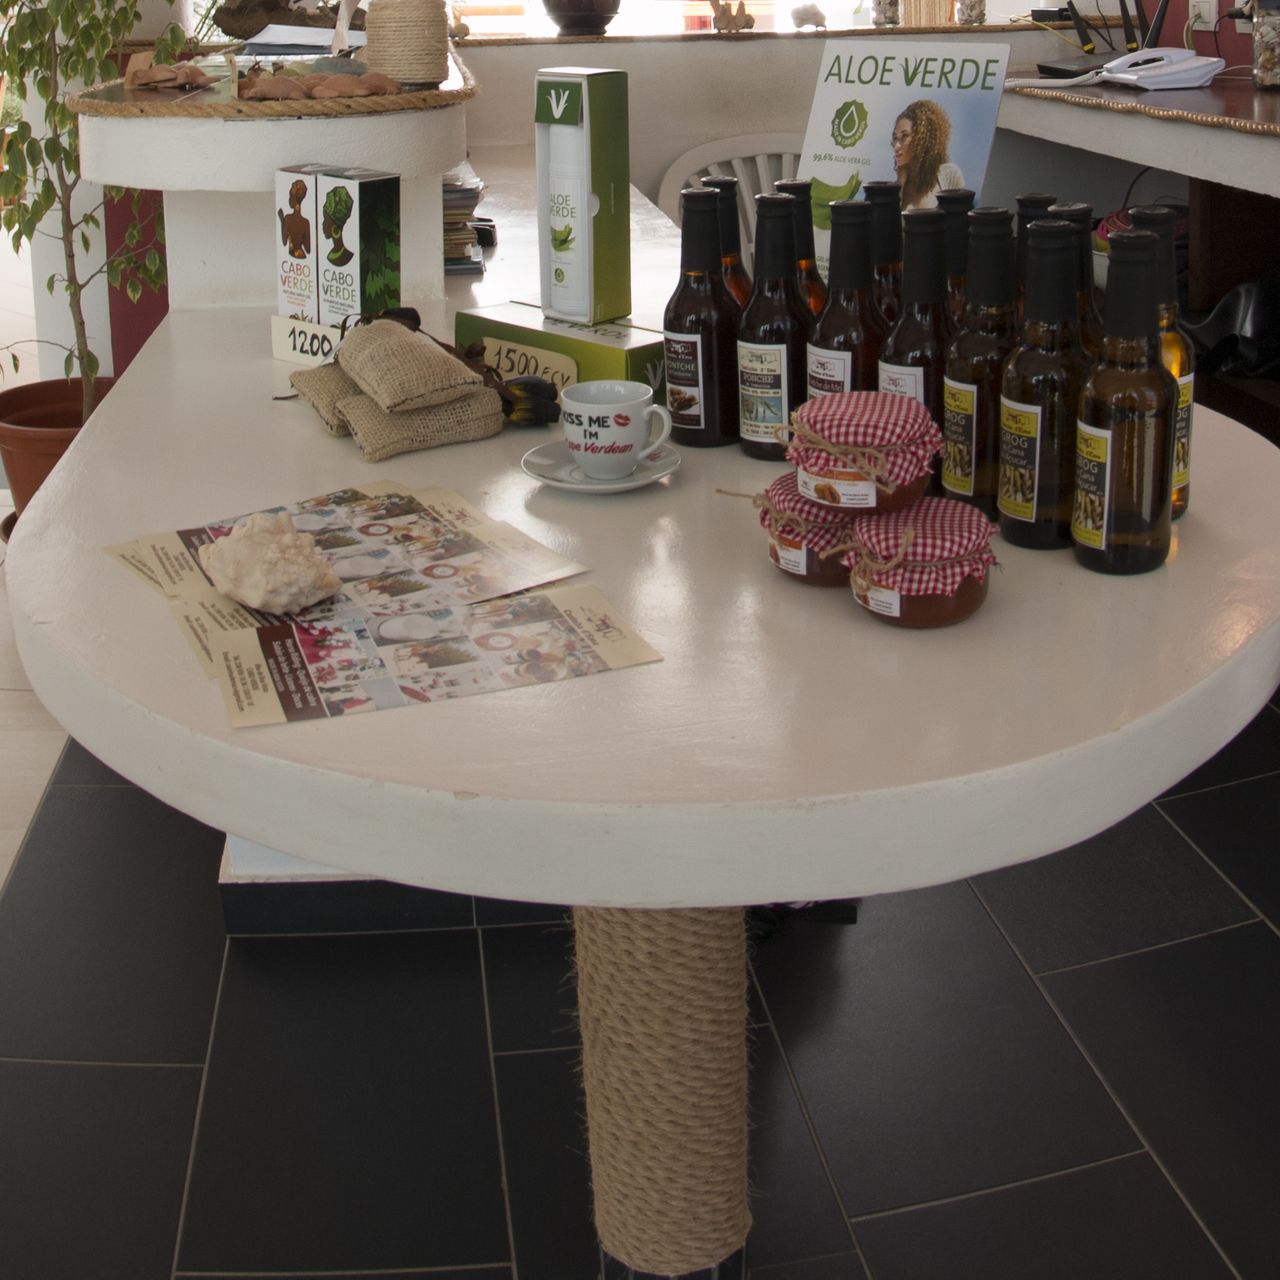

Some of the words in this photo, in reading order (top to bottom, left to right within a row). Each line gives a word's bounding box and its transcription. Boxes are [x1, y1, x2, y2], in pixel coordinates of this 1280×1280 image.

[824, 54, 896, 86] ALOE
[898, 55, 999, 91] VERDE
[549, 205, 577, 218] ERDE
[281, 260, 311, 278] CABO
[323, 268, 354, 287] CABO
[280, 274, 314, 293] VERDE
[322, 282, 356, 303] VERDE
[288, 326, 333, 357] 1200
[588, 415, 611, 428] ME
[583, 428, 599, 441] I'M
[584, 441, 634, 455] Verdean
